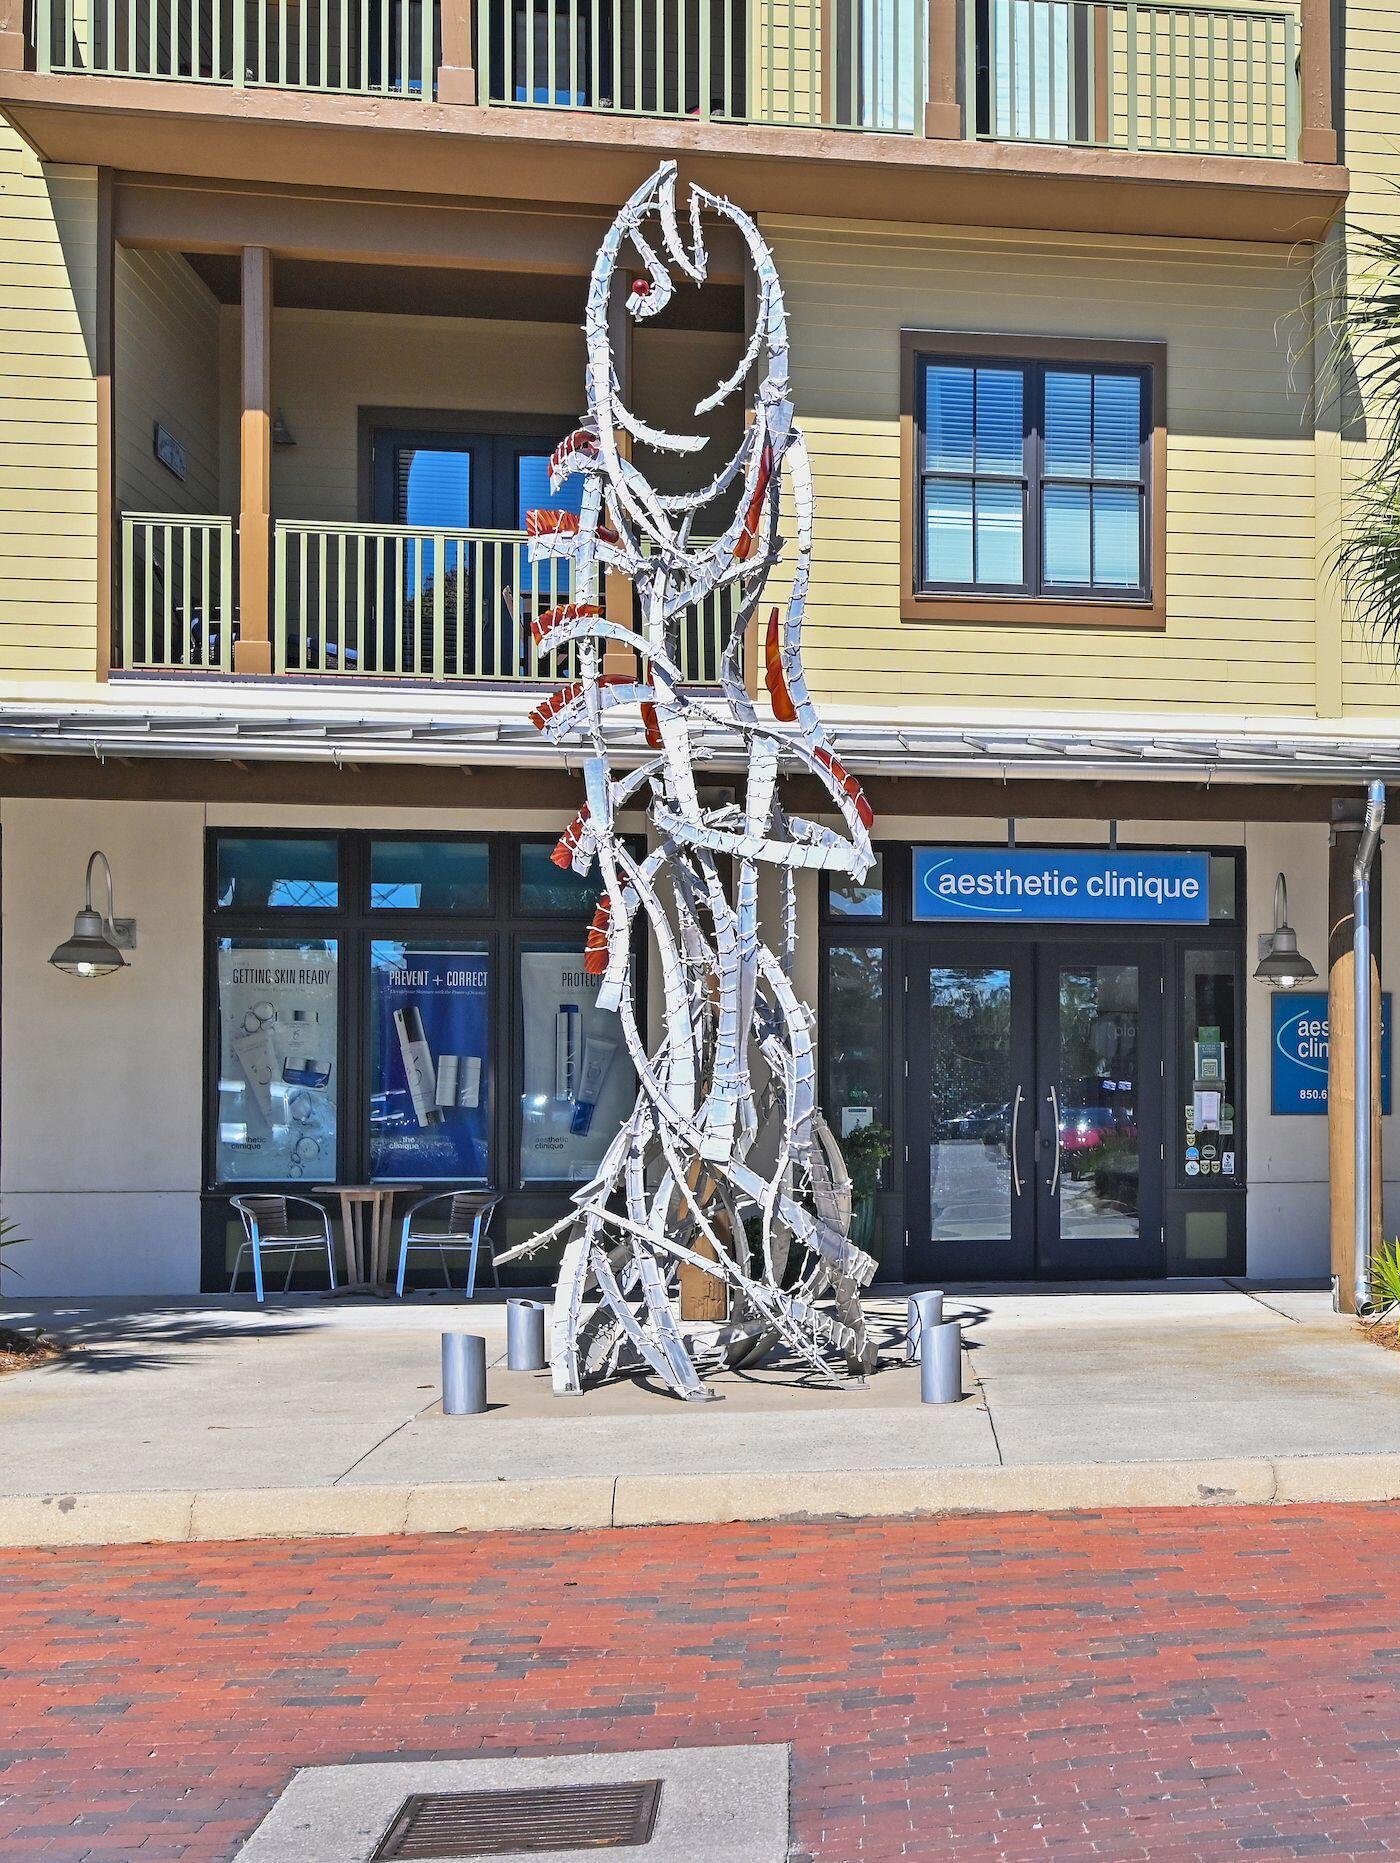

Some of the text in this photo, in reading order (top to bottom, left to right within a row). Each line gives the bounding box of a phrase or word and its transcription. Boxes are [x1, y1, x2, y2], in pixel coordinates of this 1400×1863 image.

[938, 869, 1199, 904] aesthetic clinique
[232, 968, 331, 985] GETTING SKIN READY
[389, 970, 429, 986] PREVENT
[446, 971, 488, 987] CORRECT
[1297, 1038, 1328, 1058] clin
[231, 1142, 262, 1150] clinique
[535, 1142, 564, 1150] clinique
